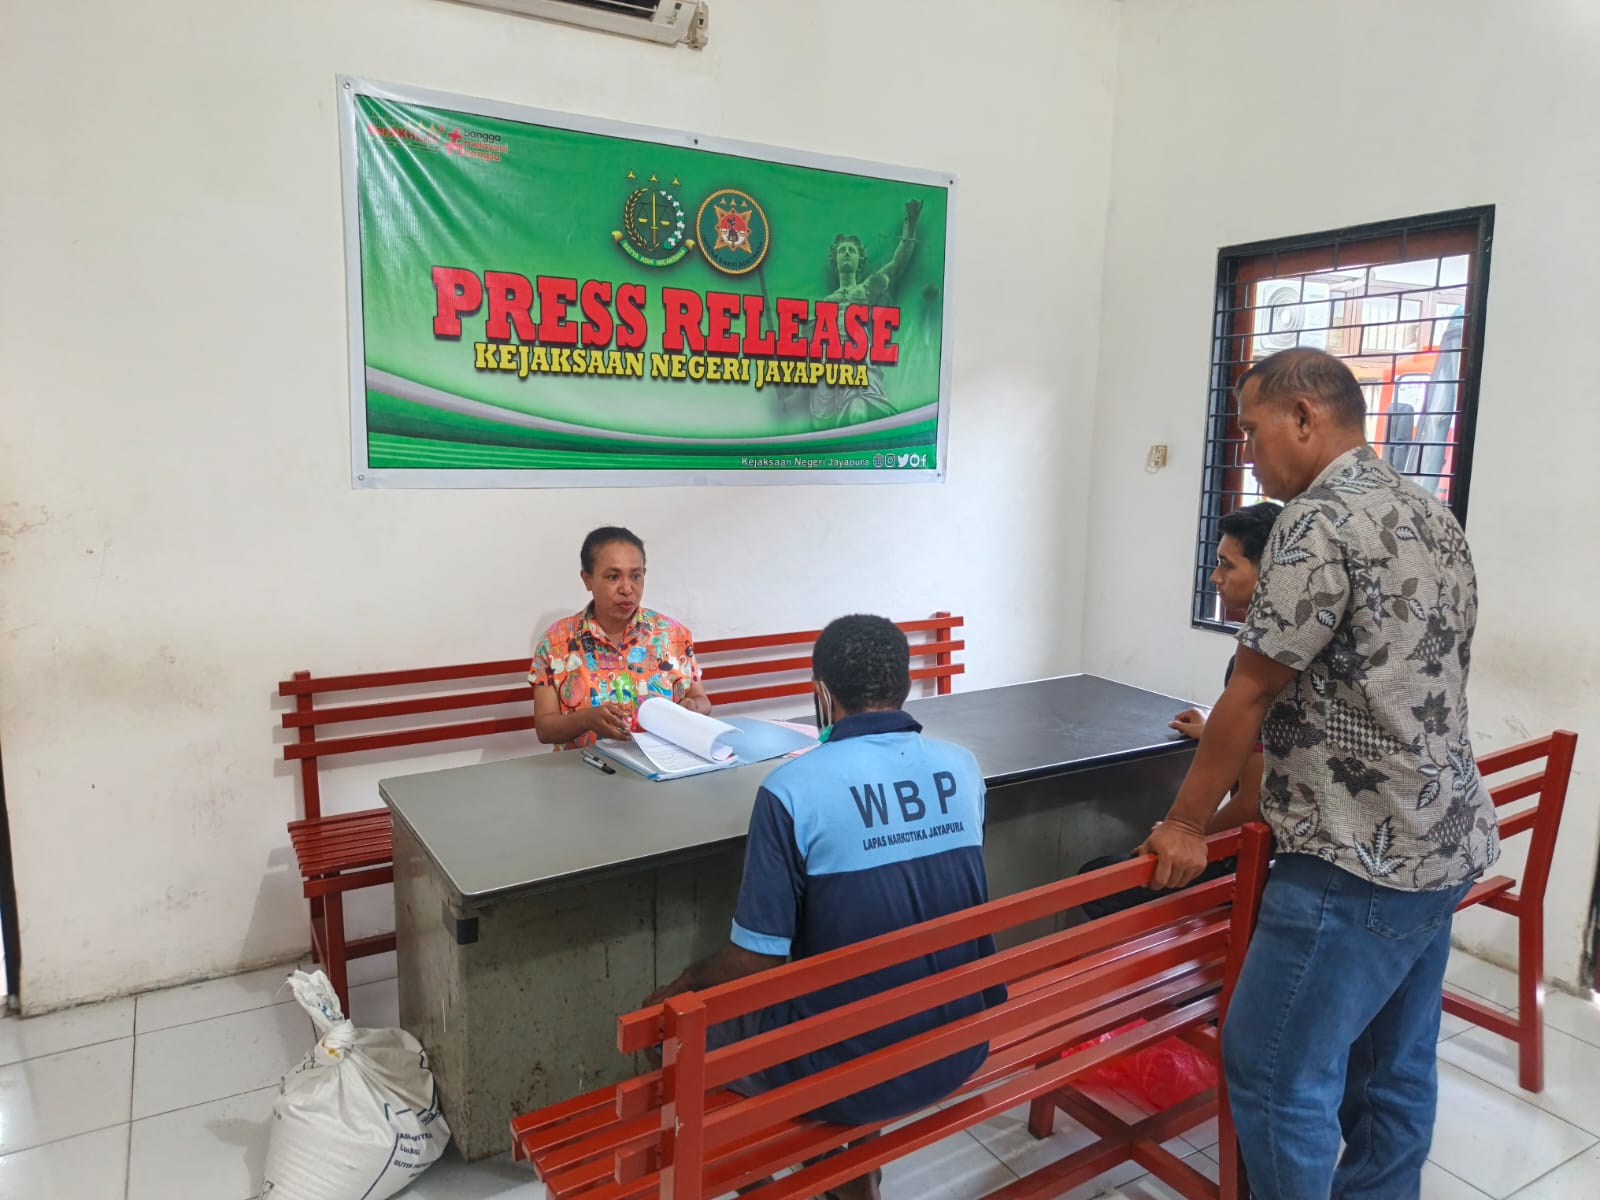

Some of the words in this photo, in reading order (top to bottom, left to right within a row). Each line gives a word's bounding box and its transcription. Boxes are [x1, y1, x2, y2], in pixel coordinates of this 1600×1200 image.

[464, 129, 501, 143] bangga
[431, 265, 648, 348] PRESS
[661, 287, 900, 364] RELEASE
[474, 342, 645, 378] KEJAKSAAN
[650, 351, 750, 382] NEGERI
[755, 358, 869, 389] JAYAPURA
[741, 457, 792, 468] Kejaksaan
[794, 457, 825, 468] Negeri
[828, 458, 870, 468] Jayapura
[863, 835, 887, 851] LAPAS
[887, 830, 928, 845] NARKOTIKA
[929, 822, 965, 838] JAYAPURA
